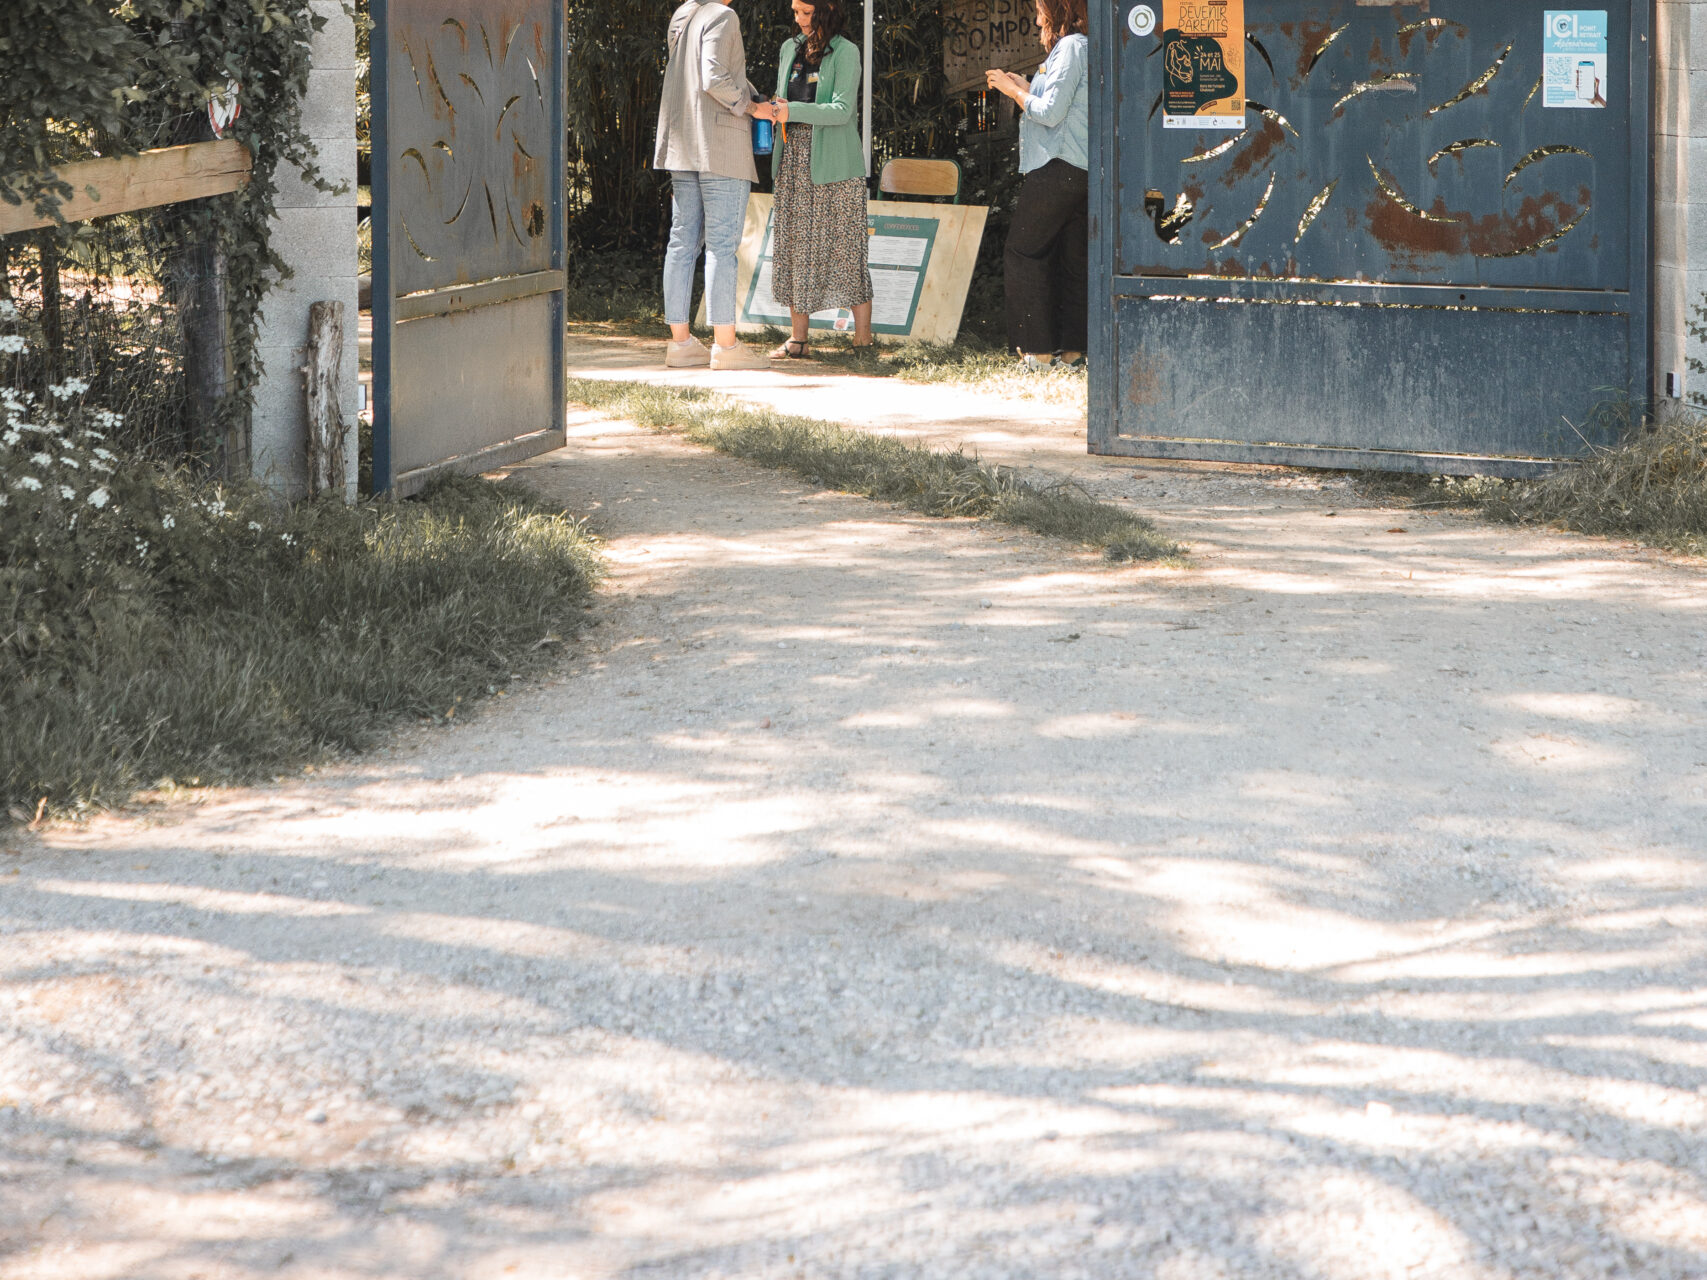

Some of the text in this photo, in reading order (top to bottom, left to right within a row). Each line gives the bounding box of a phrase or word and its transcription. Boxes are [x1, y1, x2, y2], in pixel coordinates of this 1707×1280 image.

[1179, 6, 1227, 19] DEVENIR
[1178, 19, 1229, 32] PARENTS
[1546, 14, 1578, 38] ICI
[1200, 58, 1221, 71] MAI
